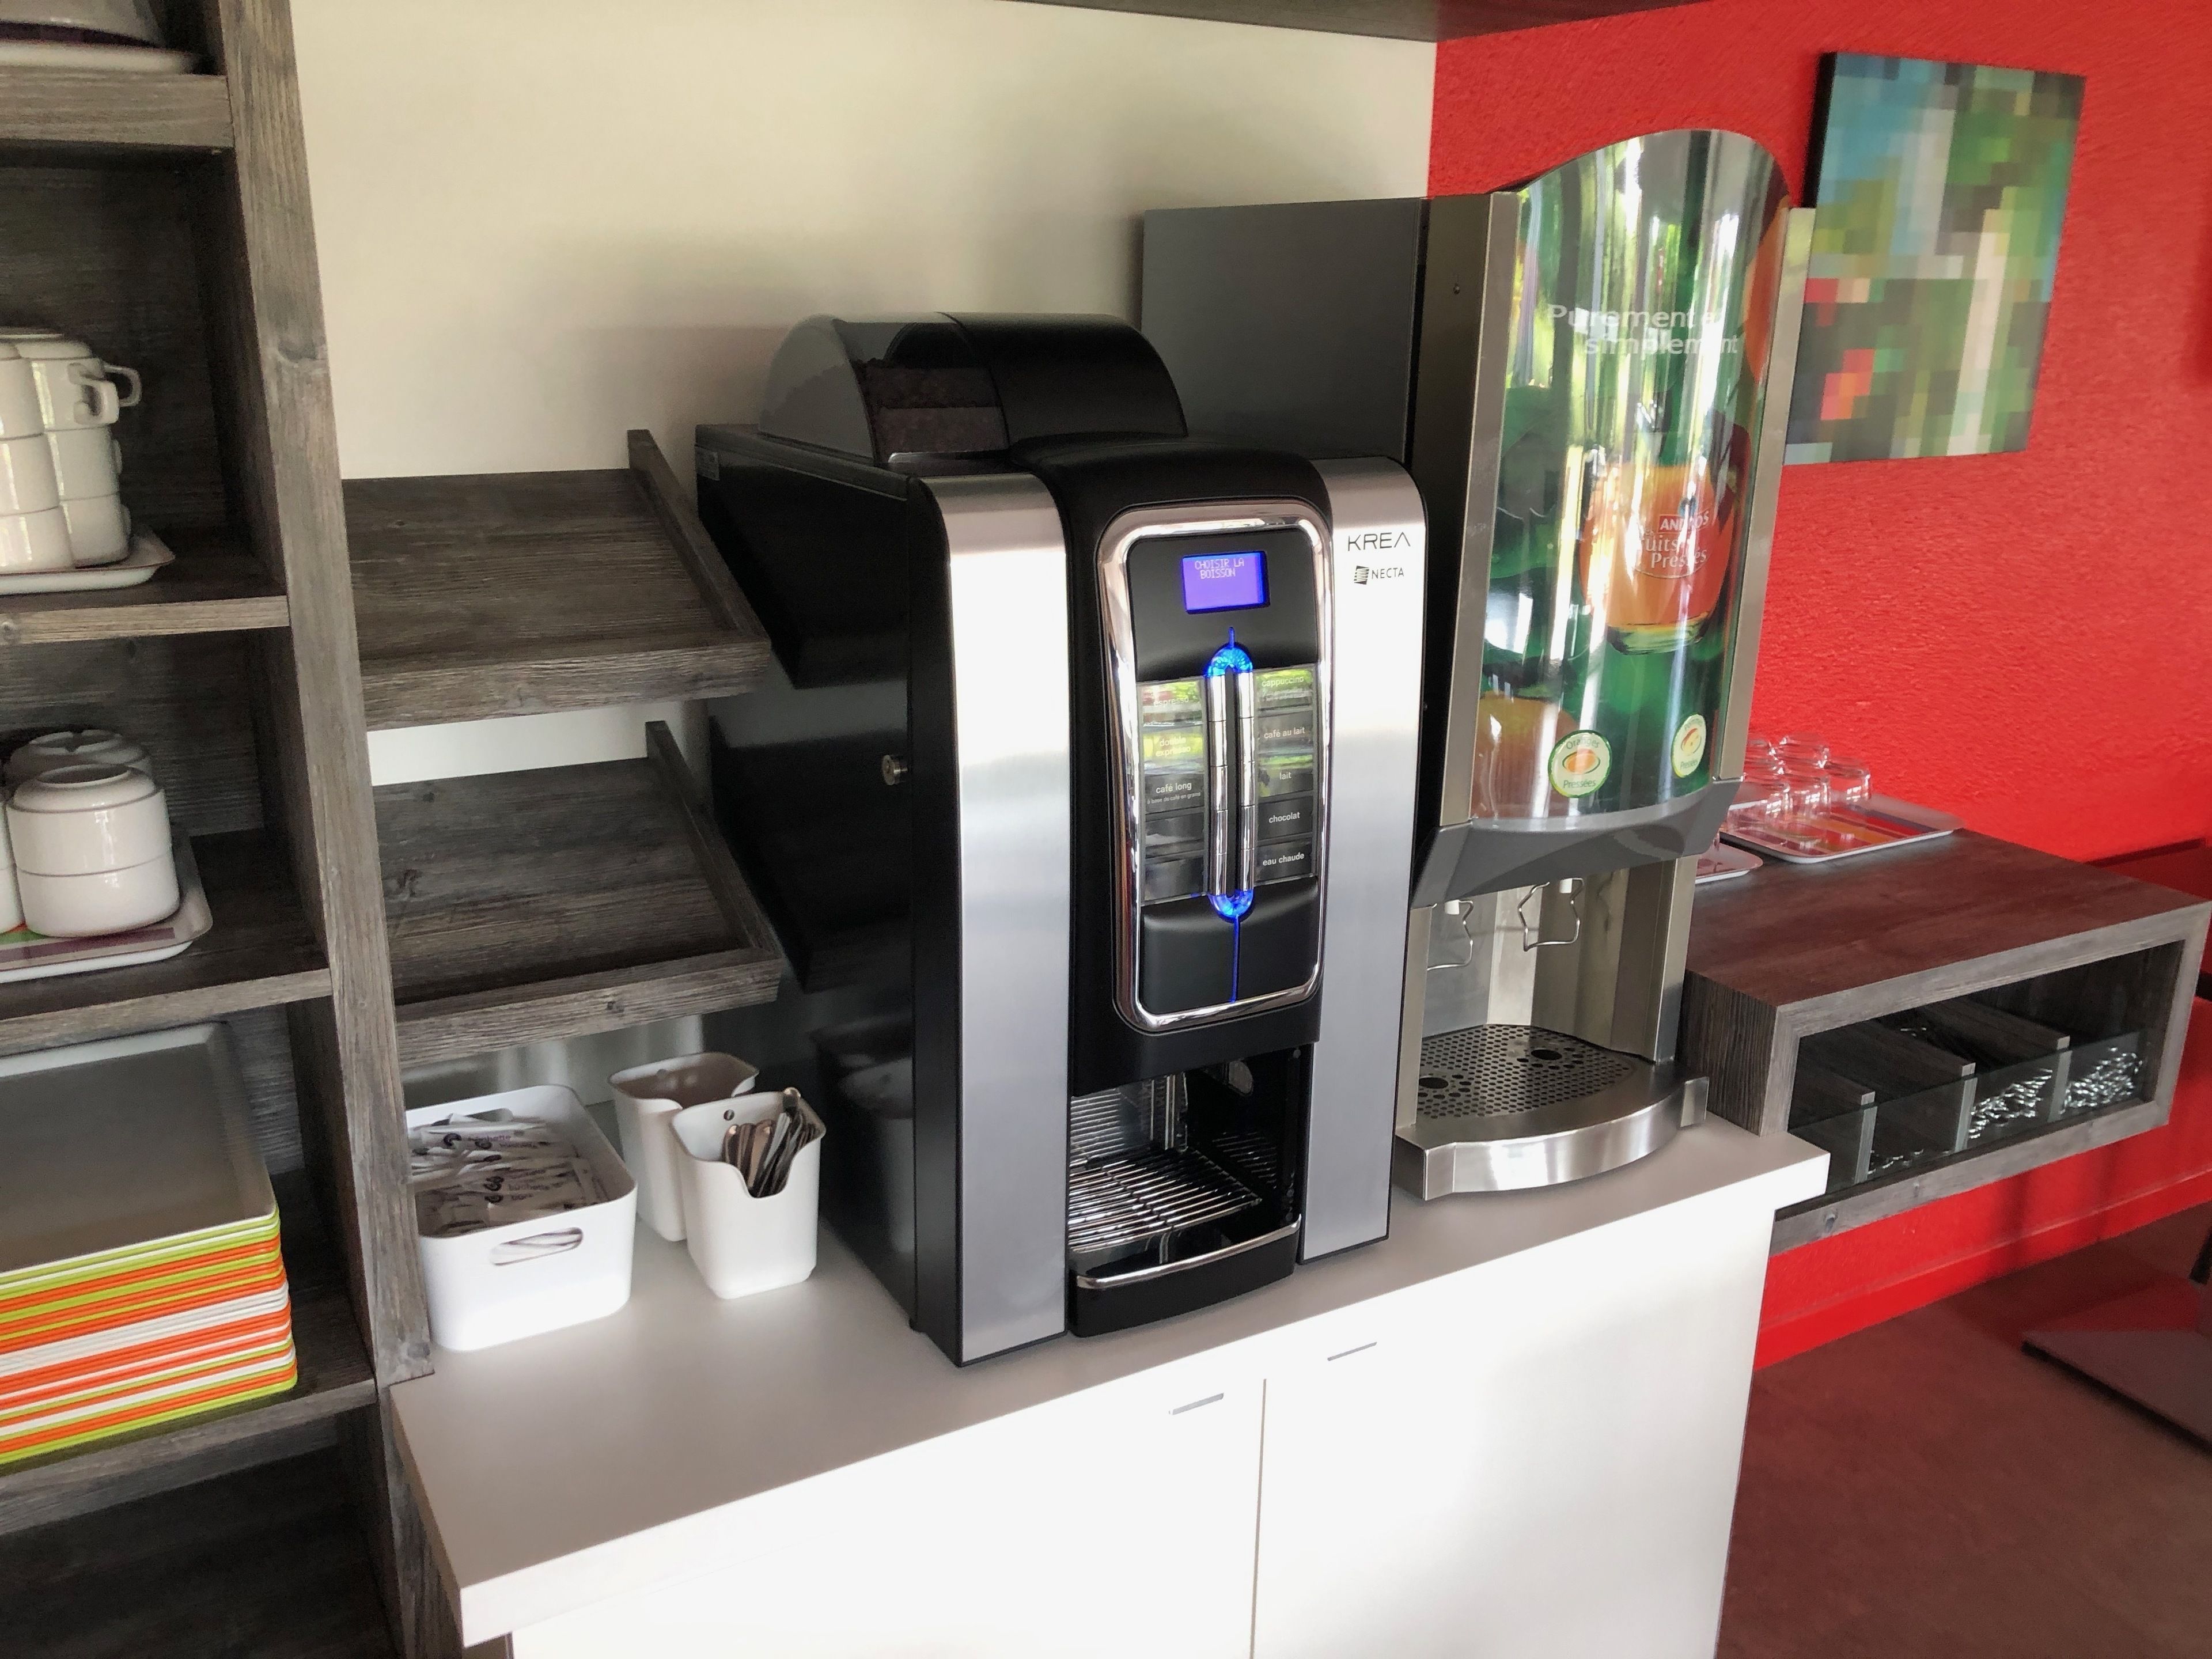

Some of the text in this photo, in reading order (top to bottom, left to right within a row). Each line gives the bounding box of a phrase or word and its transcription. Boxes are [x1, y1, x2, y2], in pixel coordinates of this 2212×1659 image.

[1548, 304, 1695, 328] Purement
[1585, 334, 1738, 360] simplemnt
[1347, 532, 1411, 551] KREA
[1194, 557, 1245, 570] CHOISIR LA
[1200, 568, 1236, 579] BOISSON
[1372, 567, 1404, 579] NECTA
[1262, 676, 1304, 688] cappuccino
[1263, 729, 1281, 739] café
[1293, 726, 1305, 735] lait
[1566, 738, 1600, 749] Oranges
[1279, 771, 1292, 780] lait
[1156, 782, 1192, 794] café long
[1563, 780, 1596, 789] Pressées
[1268, 811, 1301, 823] chocolat
[1262, 852, 1305, 866] eau chaude
